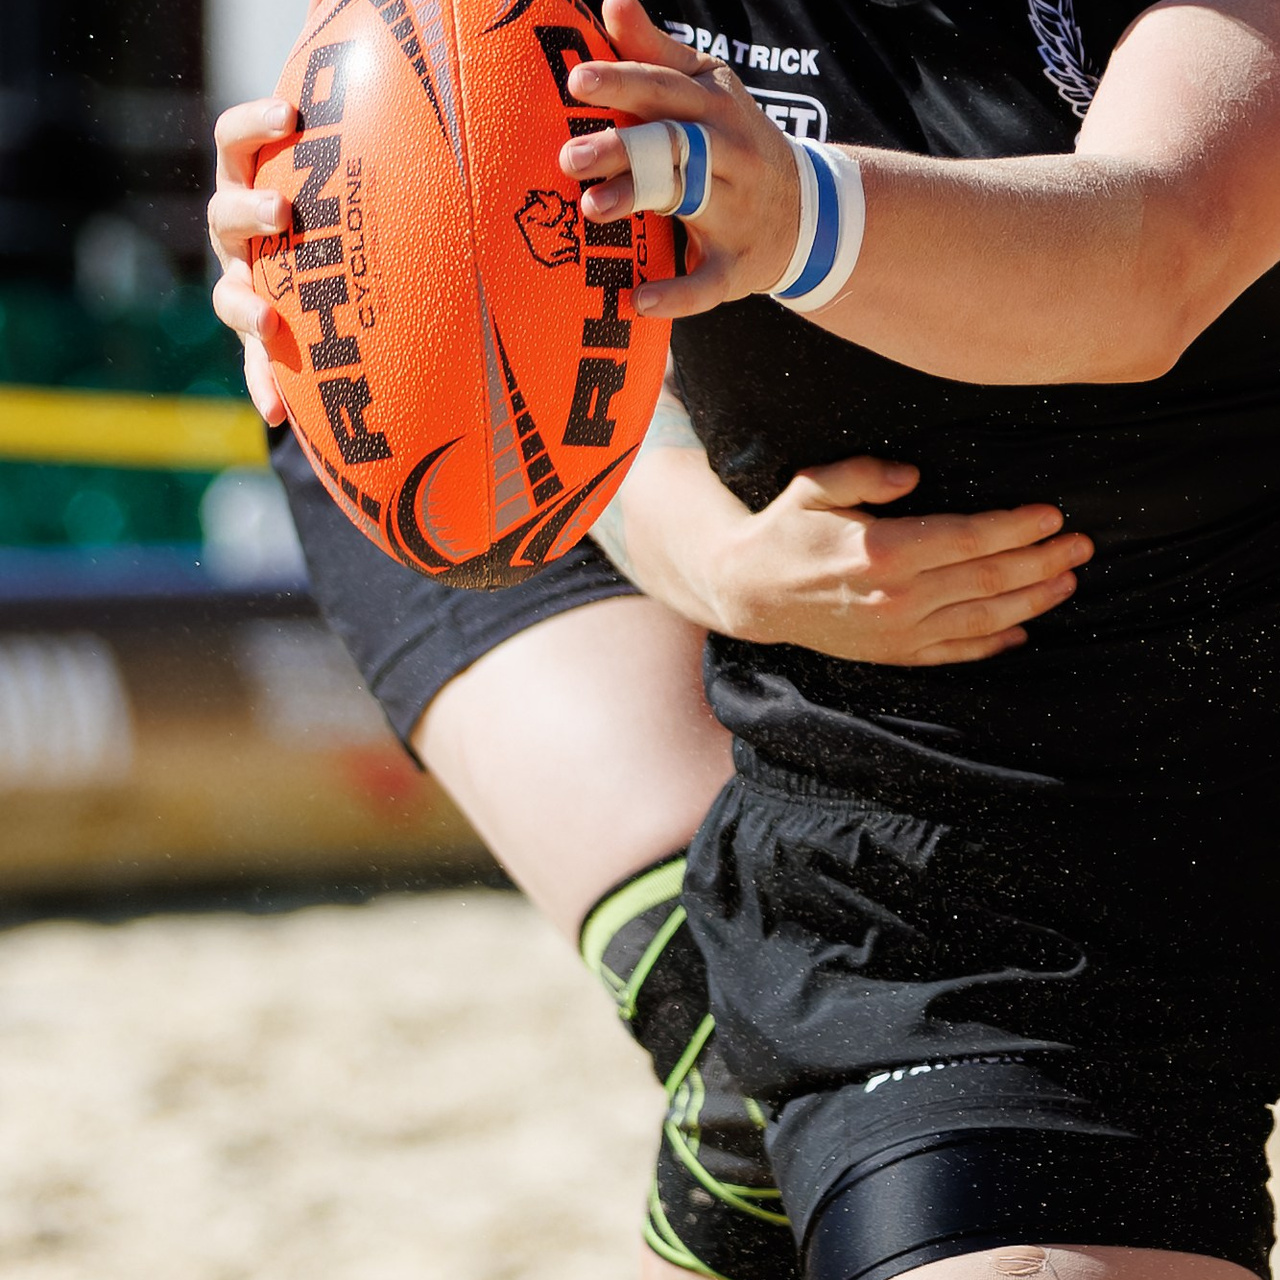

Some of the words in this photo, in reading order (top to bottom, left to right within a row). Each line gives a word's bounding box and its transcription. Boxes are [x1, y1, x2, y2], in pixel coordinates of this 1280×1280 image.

[696, 27, 821, 76] PATRICK
[291, 38, 394, 466] RHINO
[346, 156, 376, 330] CYCLONE
[533, 25, 635, 447] RHIO
